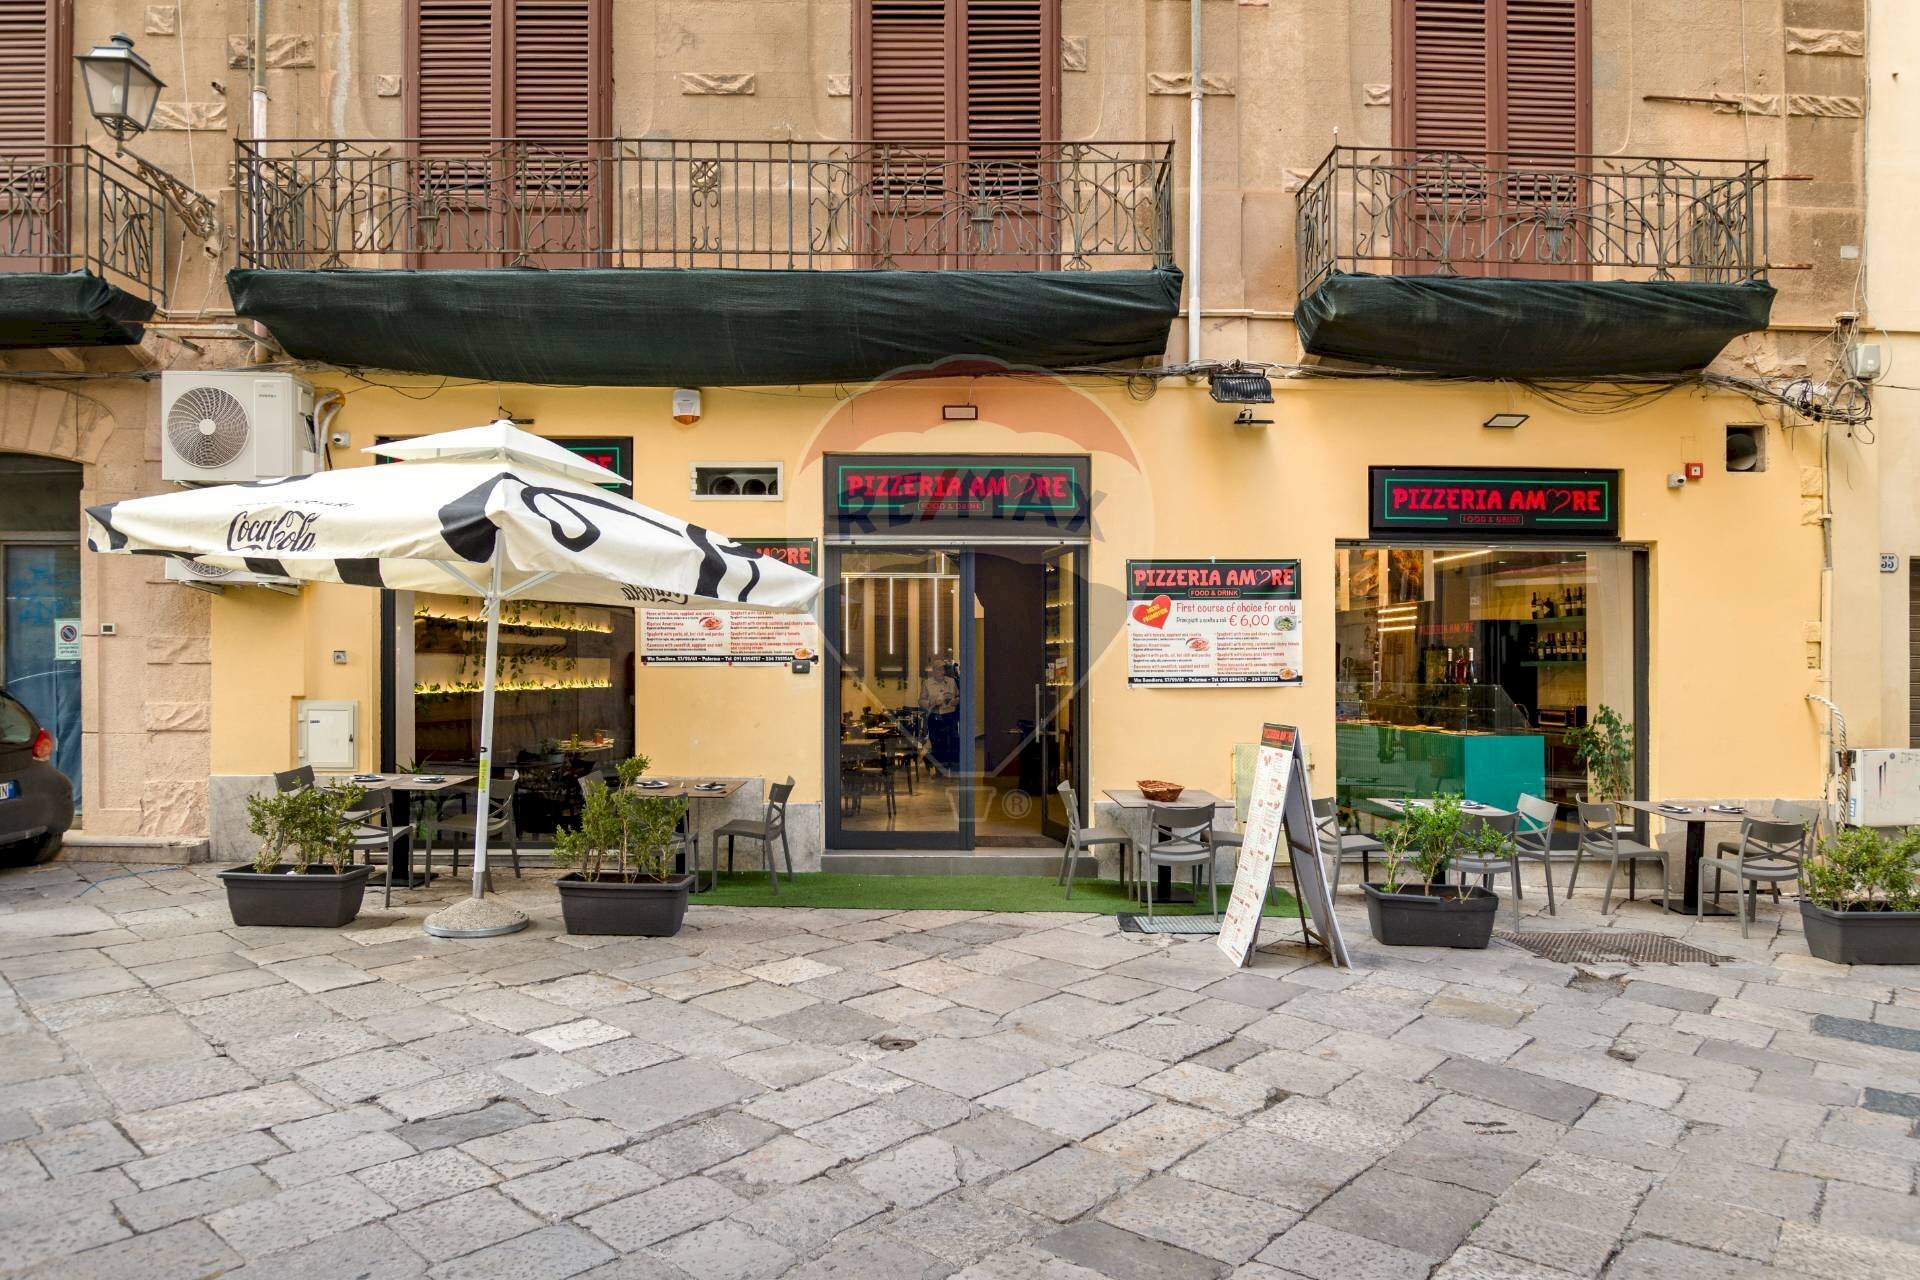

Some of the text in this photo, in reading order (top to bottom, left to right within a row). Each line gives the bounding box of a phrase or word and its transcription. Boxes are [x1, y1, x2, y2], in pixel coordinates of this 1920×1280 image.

[847, 474, 962, 498] PIZZERIA
[1392, 487, 1502, 510] PIZZERIA
[1133, 569, 1221, 587] PIZZERIA
[1190, 589, 1210, 597] FOOD
[1217, 589, 1238, 597] DRINK
[1176, 602, 1296, 615] First course of choice for only
[1230, 615, 1270, 627] € 6,00
